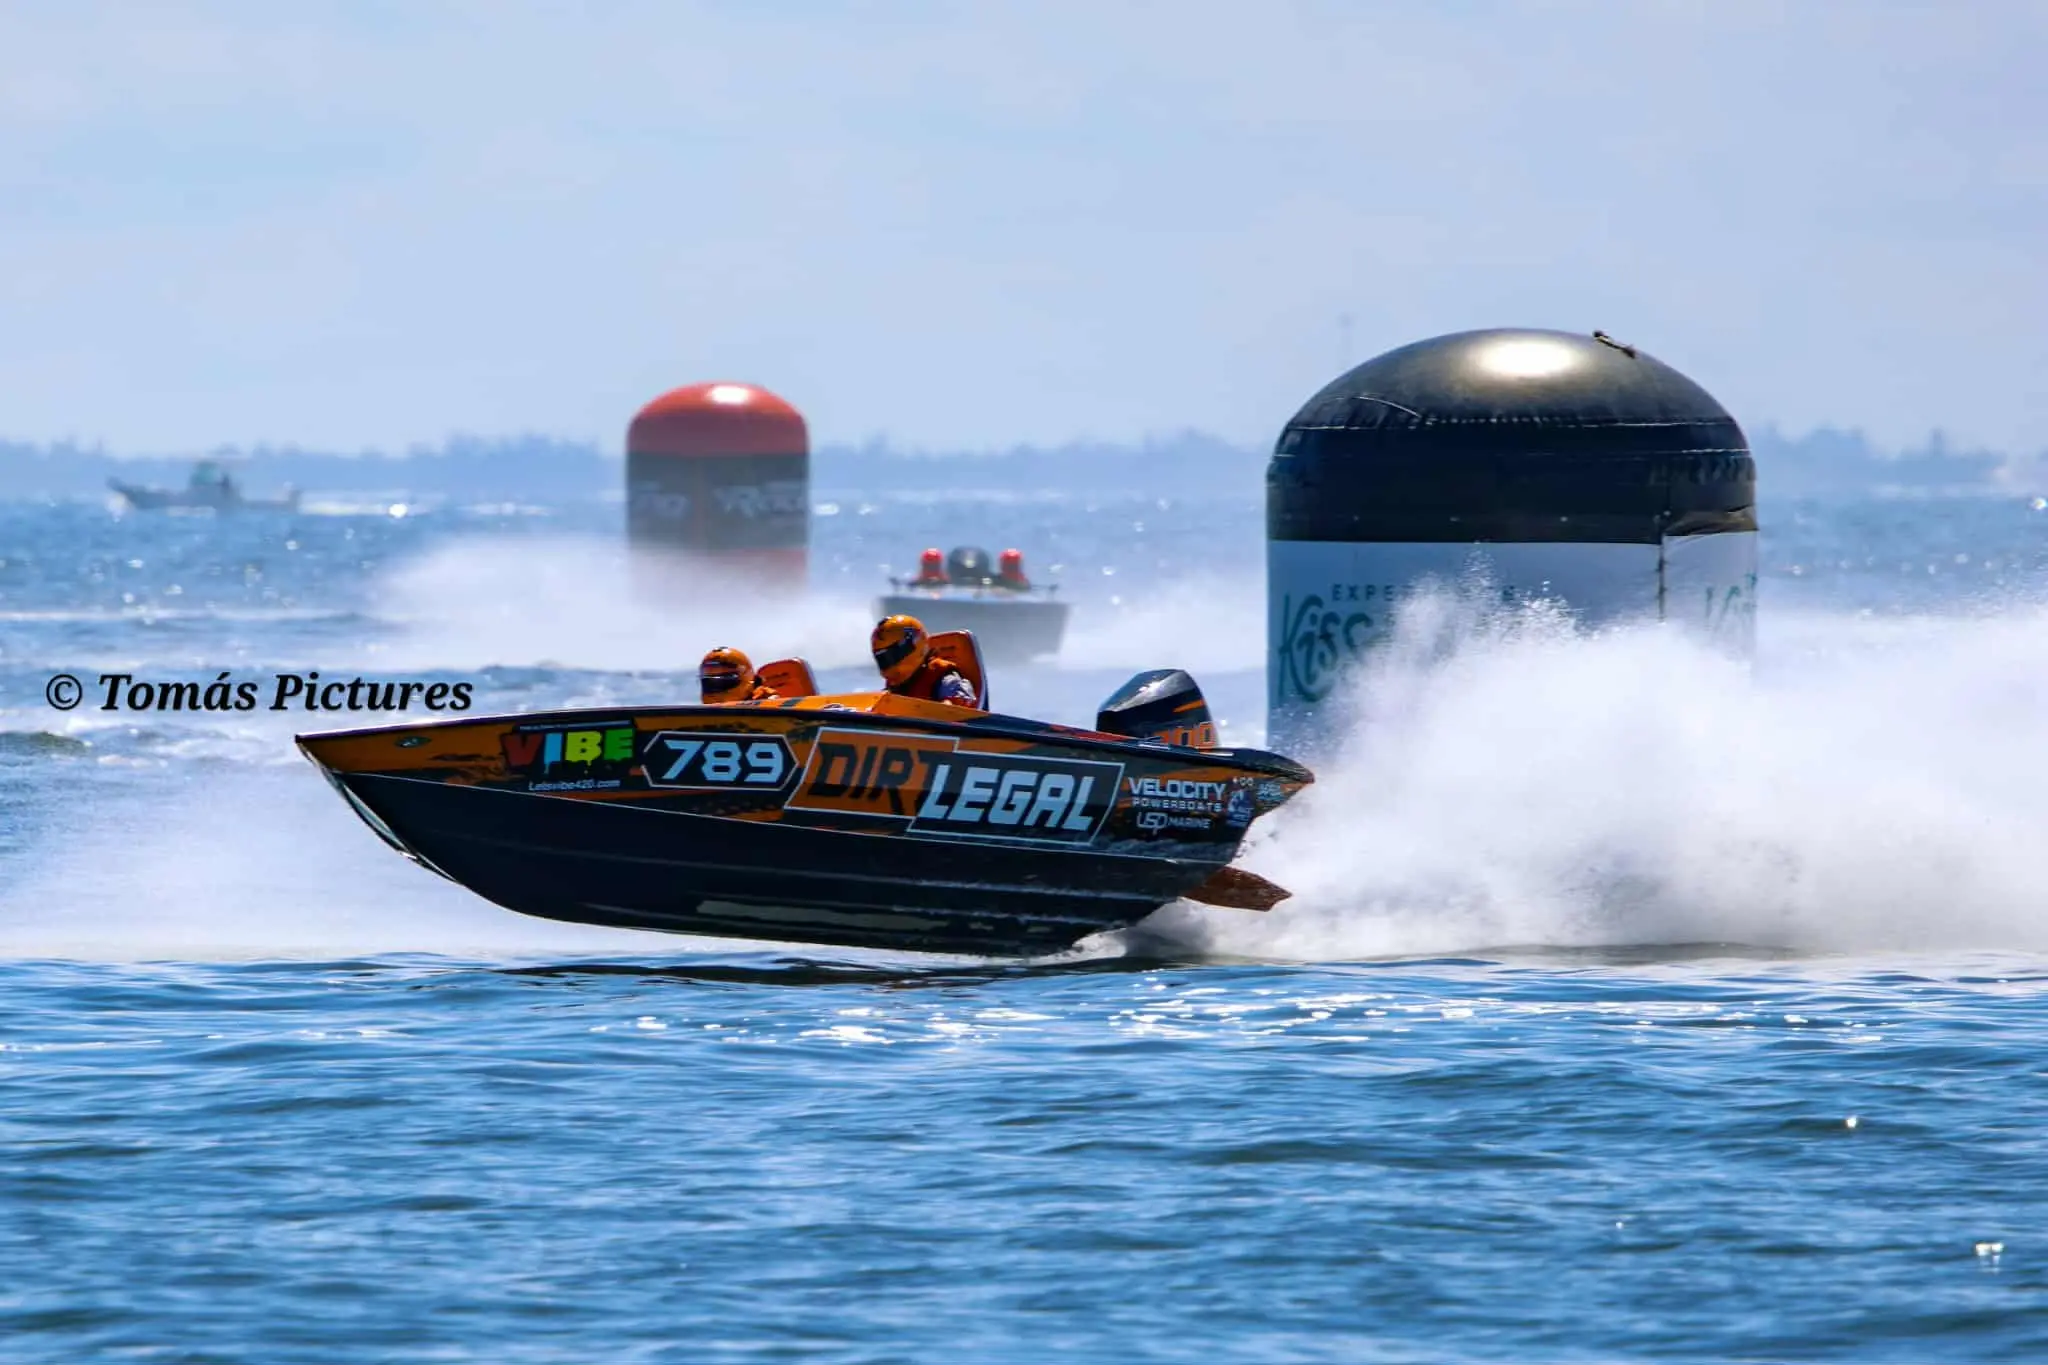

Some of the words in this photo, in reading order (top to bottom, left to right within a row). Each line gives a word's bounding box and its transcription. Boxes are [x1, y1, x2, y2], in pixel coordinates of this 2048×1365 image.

[503, 728, 634, 766] VIBE
[662, 739, 784, 783] 789
[806, 743, 946, 816] DIRT
[919, 764, 1096, 831] LEGAL
[1128, 777, 1227, 800] VELOCITY
[1132, 797, 1223, 813] POWERBOATS
